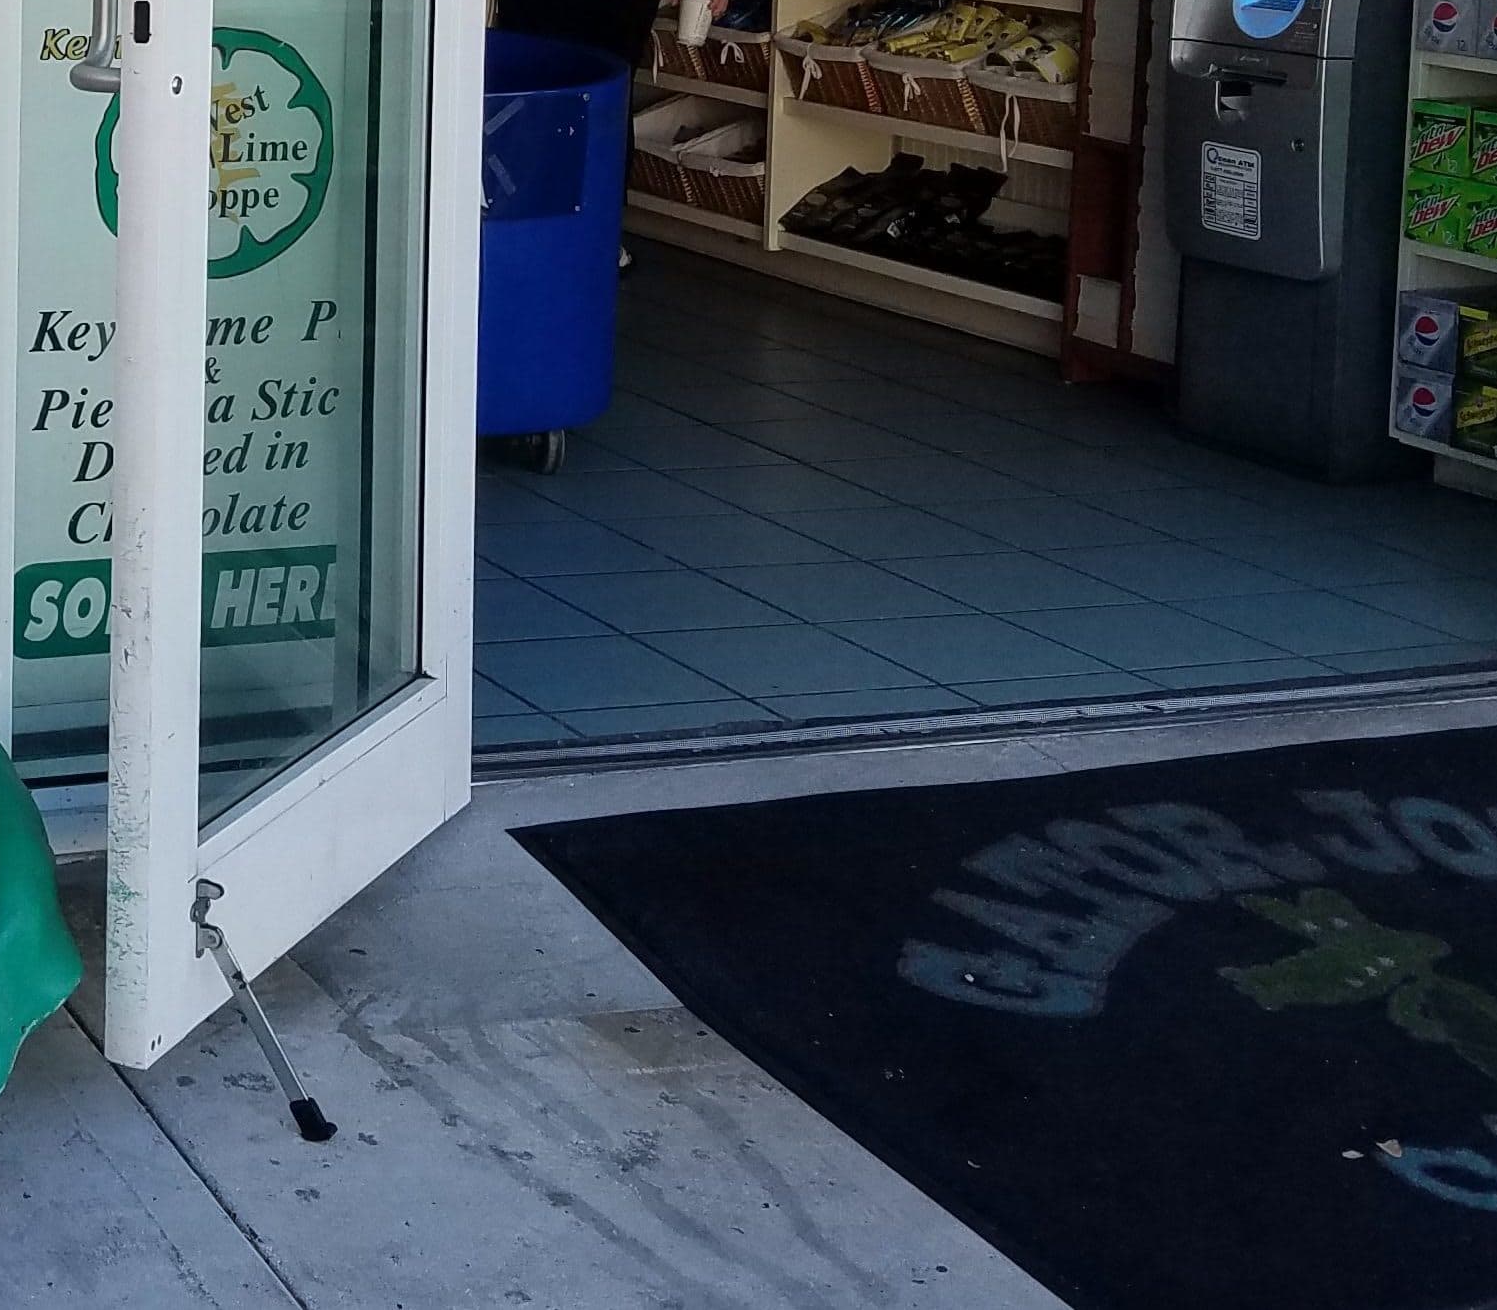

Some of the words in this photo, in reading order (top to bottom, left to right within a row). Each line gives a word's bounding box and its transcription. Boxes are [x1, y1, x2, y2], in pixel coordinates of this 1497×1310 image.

[219, 132, 309, 163] Lime
[29, 309, 117, 362] Key
[32, 387, 114, 431] Pie
[251, 376, 342, 421] Stic
[264, 430, 310, 471] in
